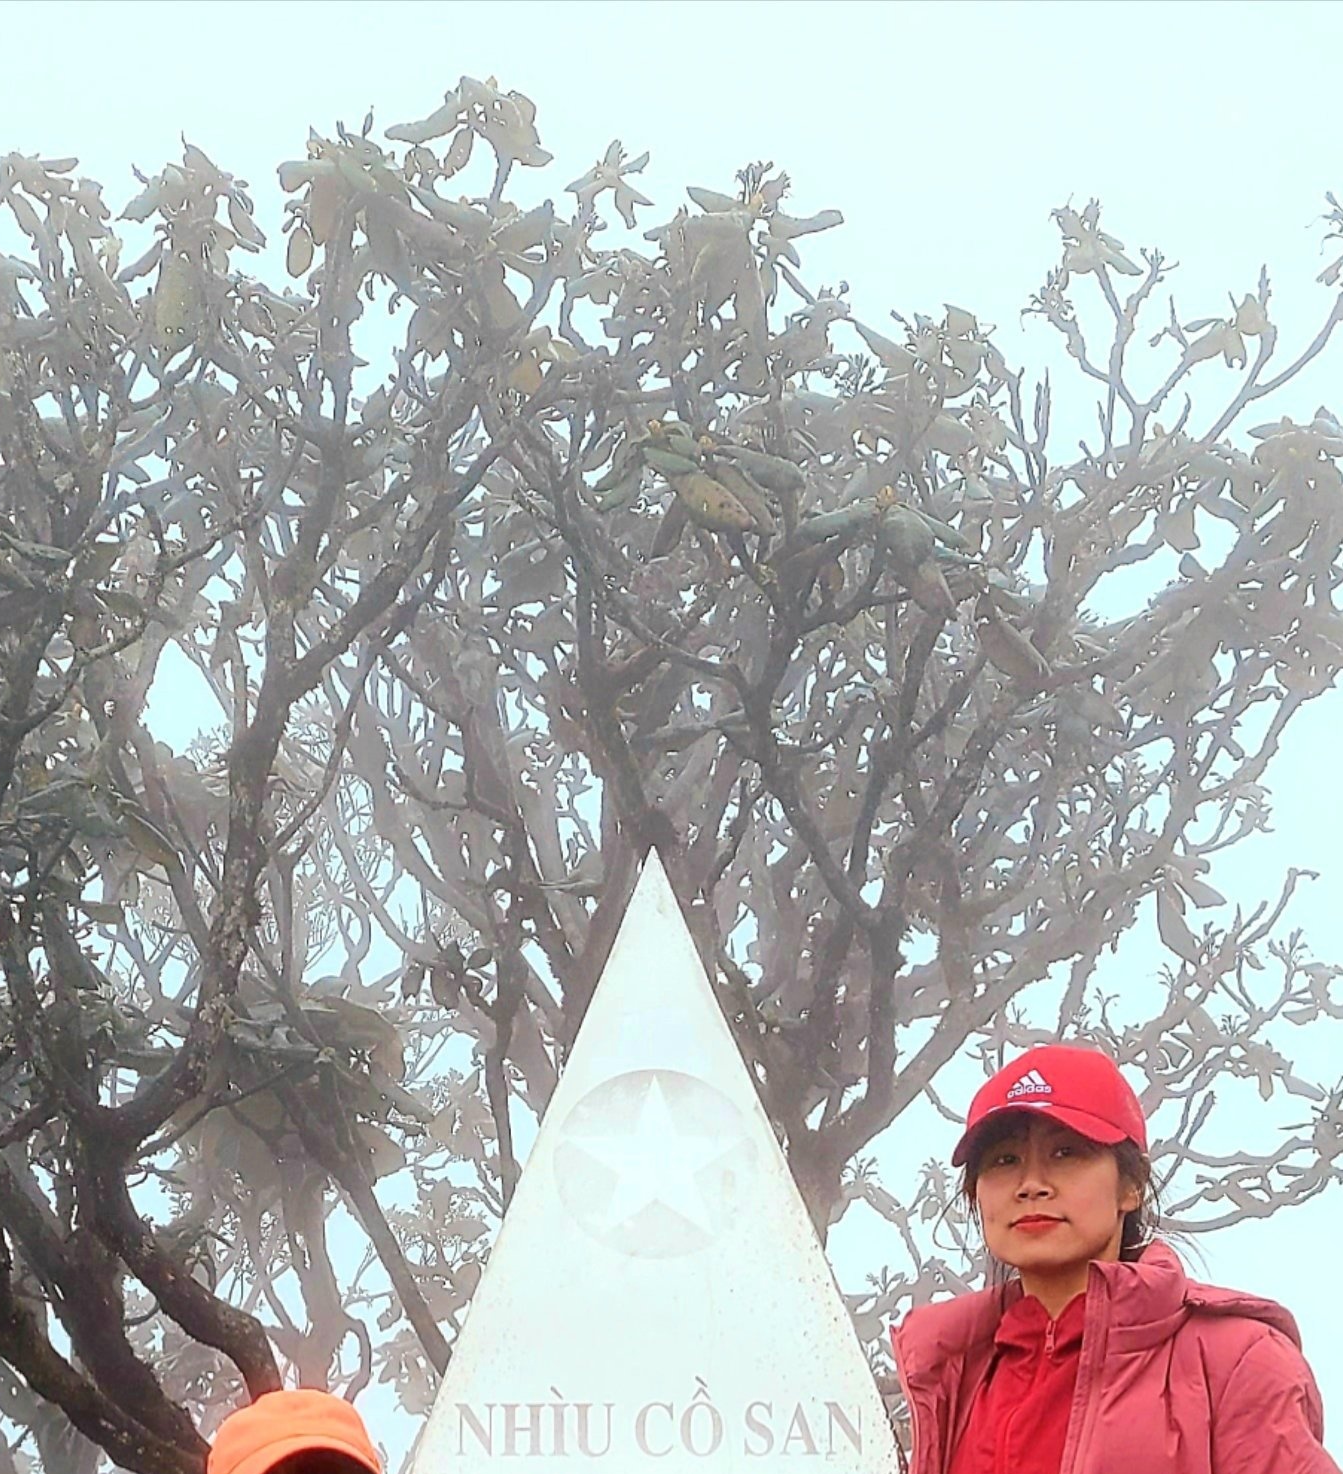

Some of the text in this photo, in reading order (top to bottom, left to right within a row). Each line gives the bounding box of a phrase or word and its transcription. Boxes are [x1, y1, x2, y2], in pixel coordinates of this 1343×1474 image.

[1007, 1083, 1052, 1098] adidas
[454, 1376, 864, 1458] NHÌU CỒ SAN
